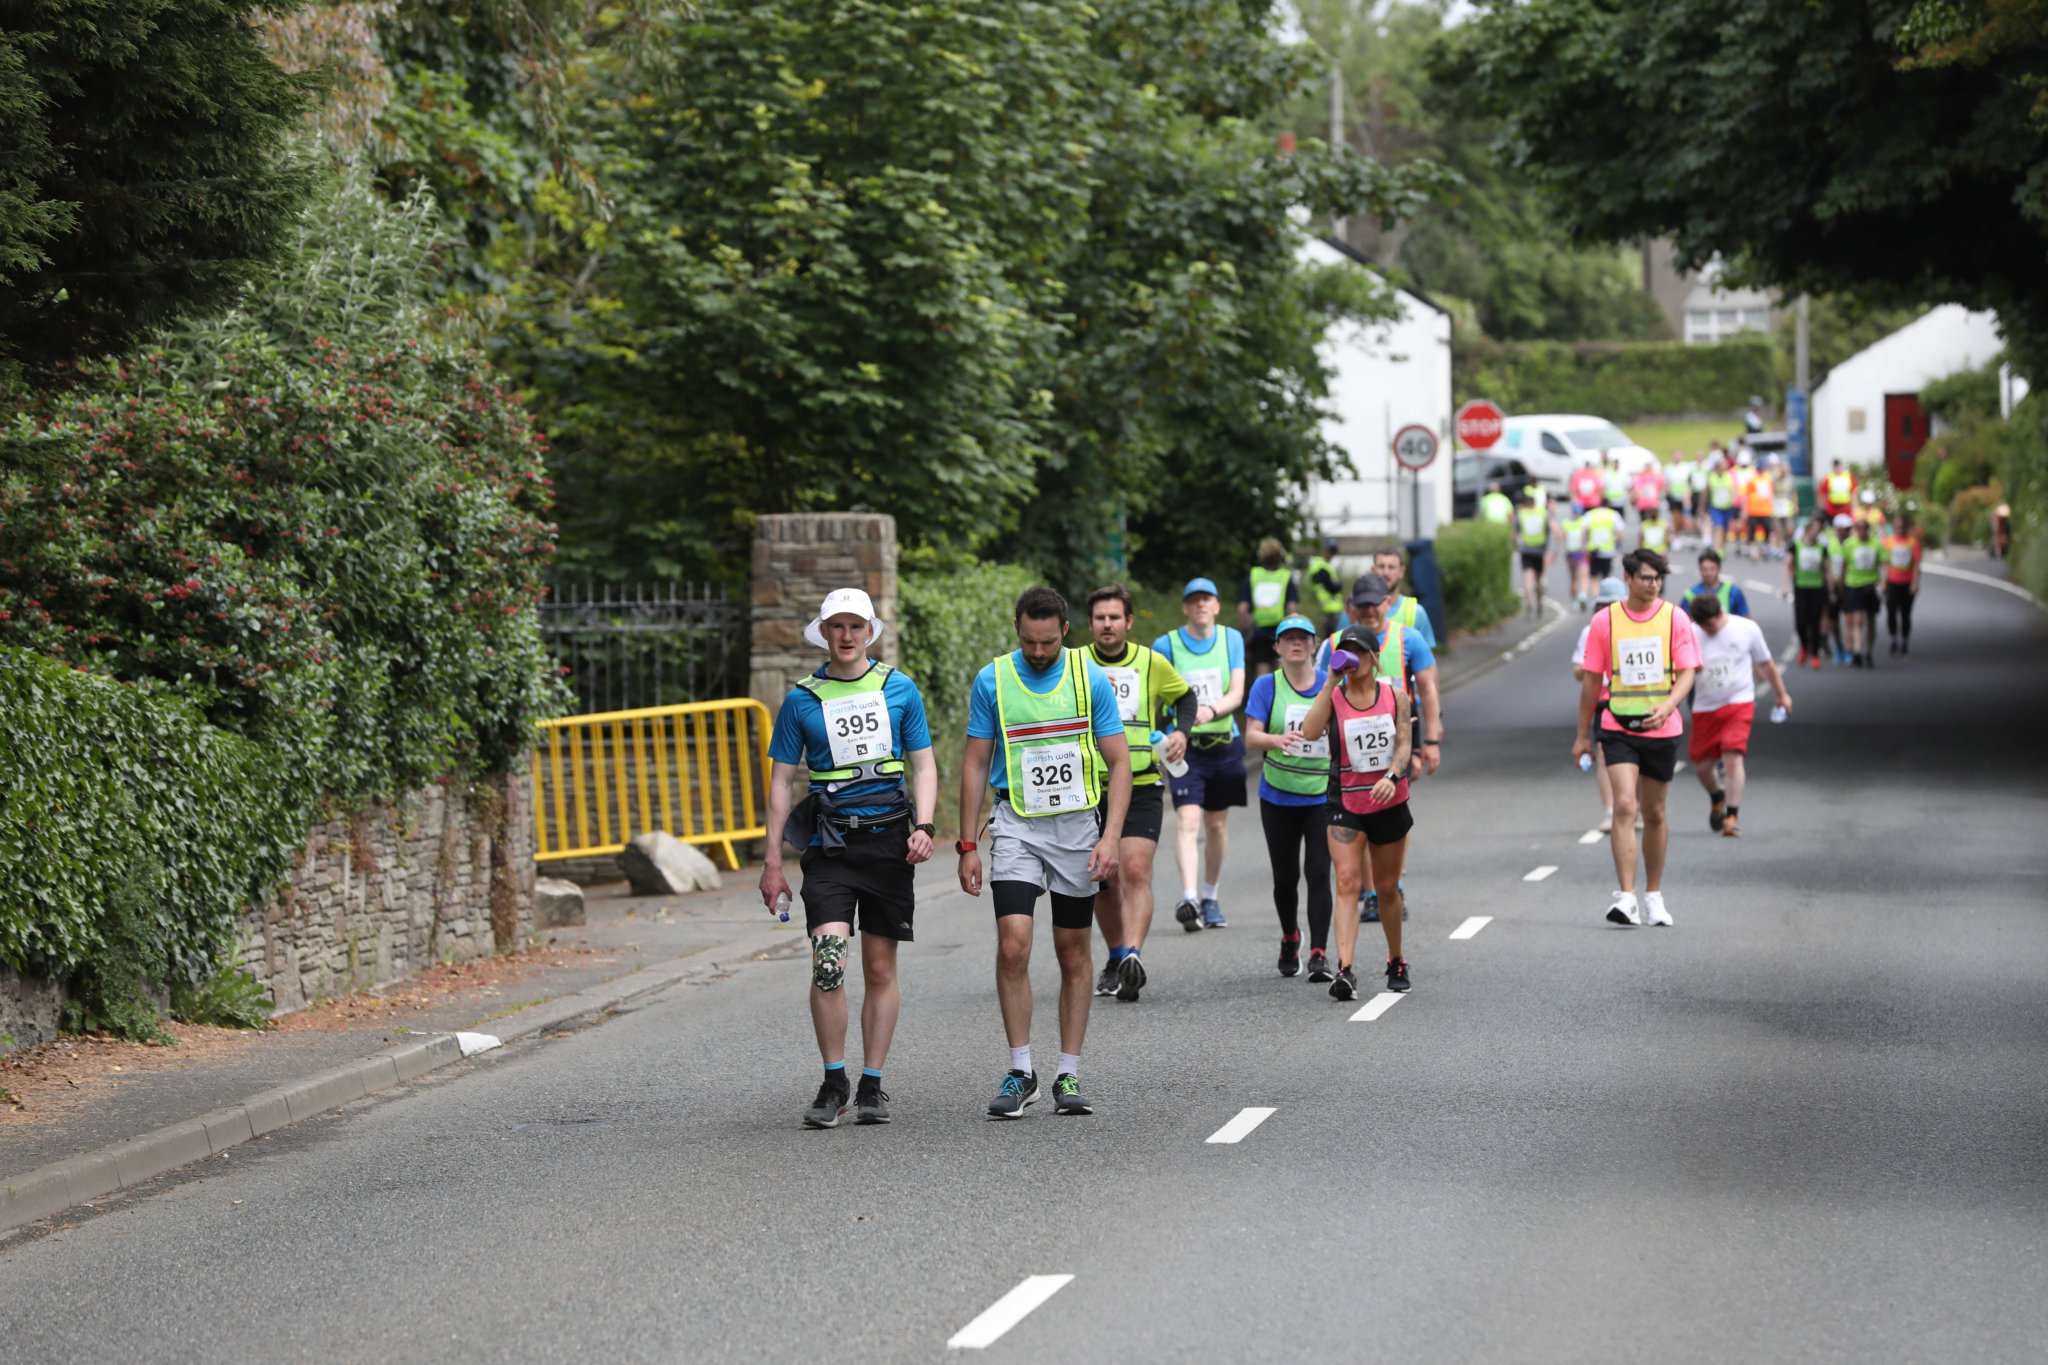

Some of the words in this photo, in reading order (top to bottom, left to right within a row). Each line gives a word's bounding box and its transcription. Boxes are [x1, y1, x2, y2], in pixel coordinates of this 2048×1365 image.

[1460, 418, 1501, 437] STOP
[1400, 437, 1434, 456] 40
[1625, 651, 1655, 666] 410
[829, 704, 858, 717] parish
[859, 699, 880, 709] walk
[835, 712, 879, 738] 395
[1354, 731, 1389, 750] 125
[1026, 754, 1054, 764] parish
[1055, 750, 1076, 761] walk
[1031, 763, 1073, 787] 326
